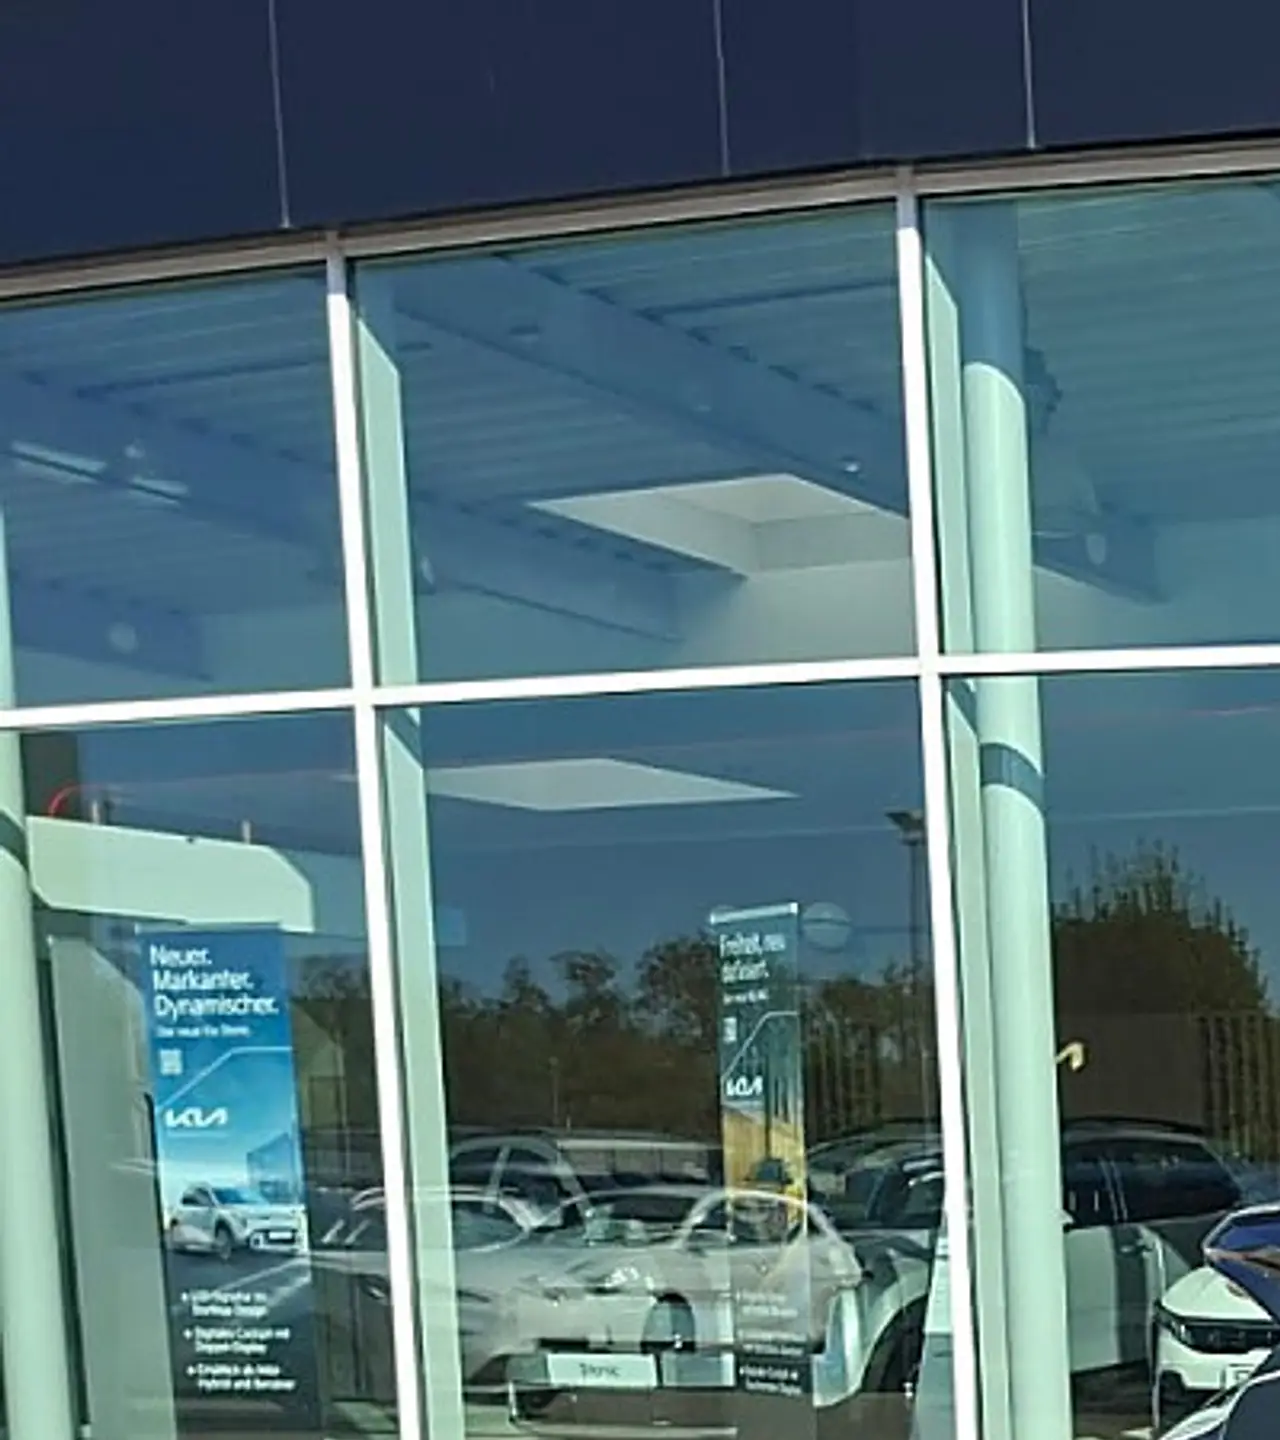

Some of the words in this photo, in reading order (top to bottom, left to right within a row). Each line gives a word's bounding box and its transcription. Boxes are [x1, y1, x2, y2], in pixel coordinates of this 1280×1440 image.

[150, 944, 212, 966] Neuer.
[153, 969, 255, 990] Markanter.
[154, 993, 280, 1022] Dynamischer.
[165, 1107, 228, 1128] KIA
